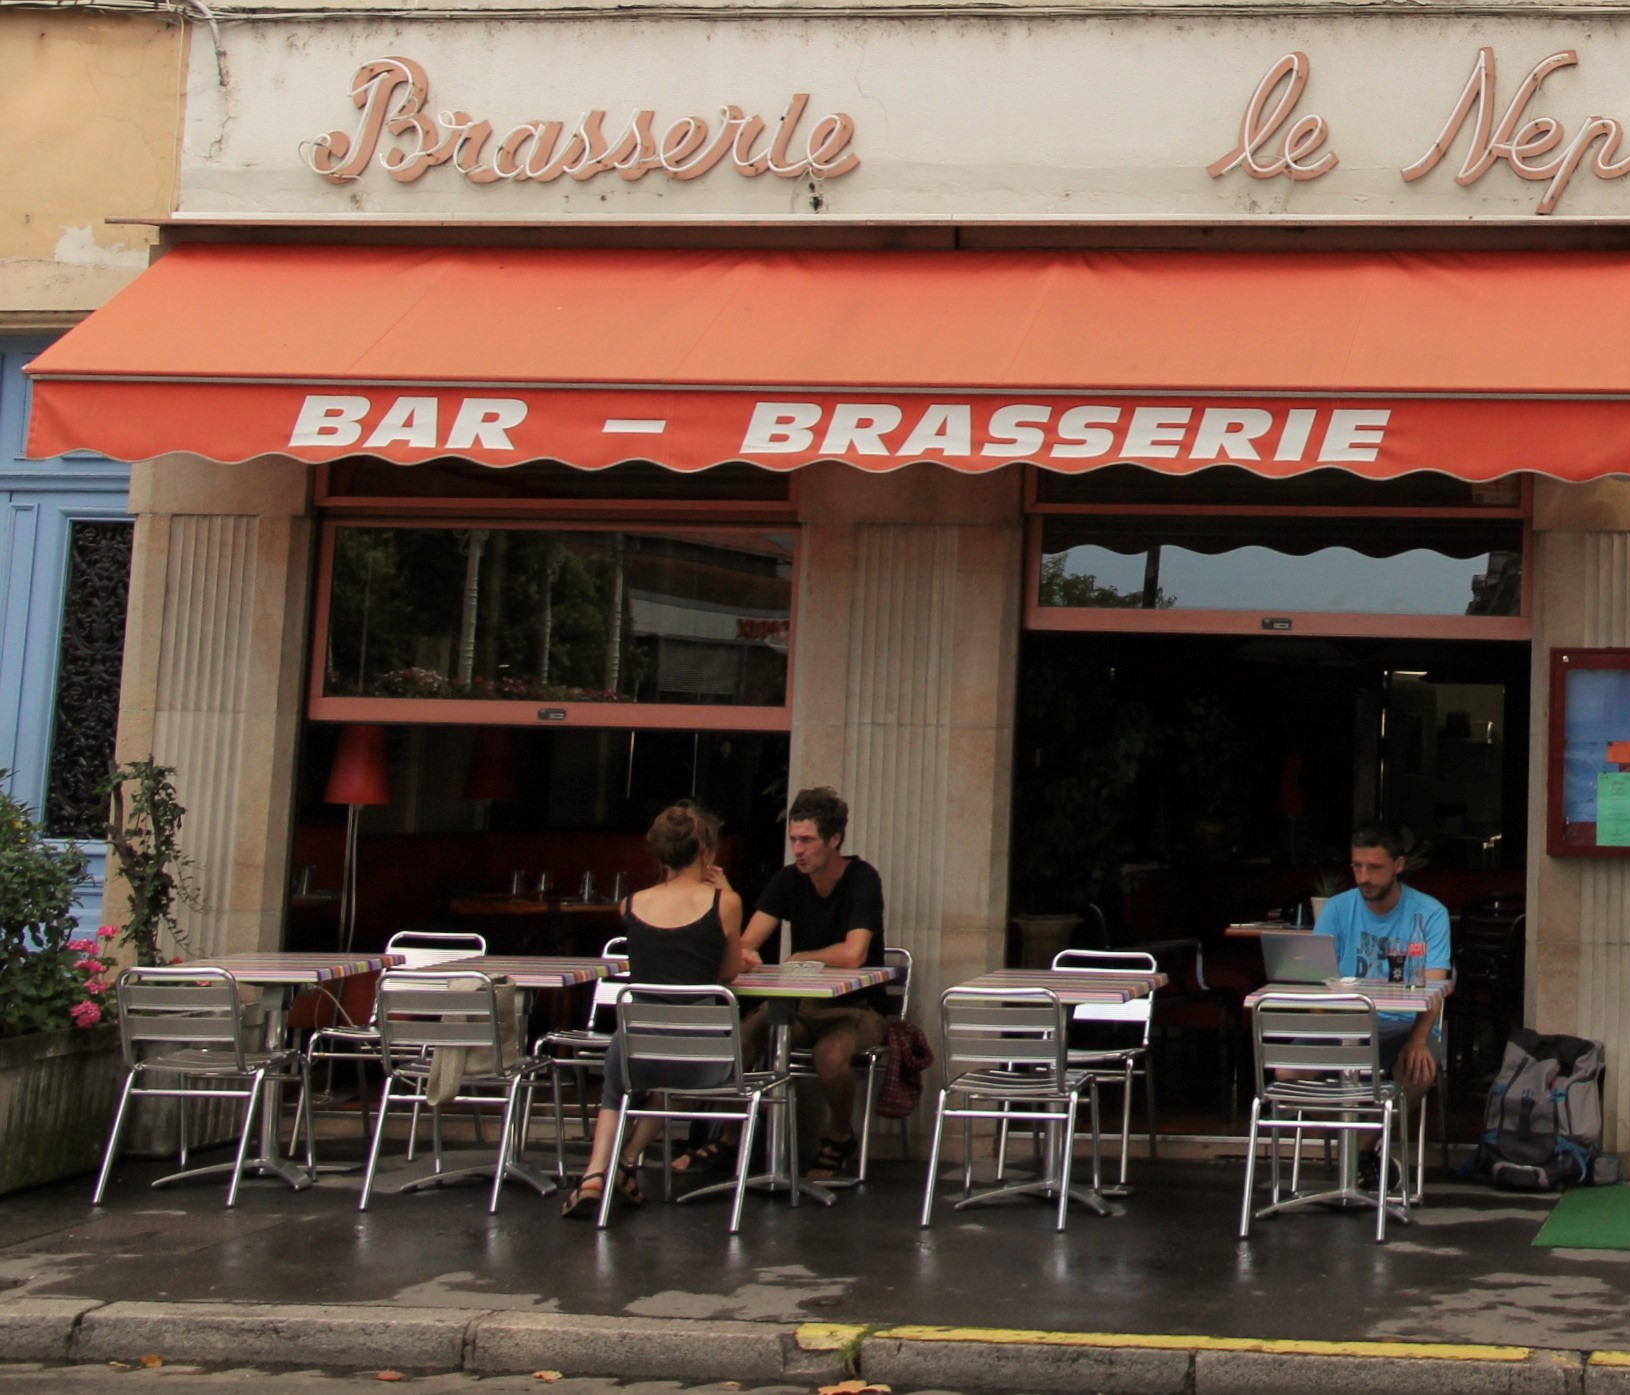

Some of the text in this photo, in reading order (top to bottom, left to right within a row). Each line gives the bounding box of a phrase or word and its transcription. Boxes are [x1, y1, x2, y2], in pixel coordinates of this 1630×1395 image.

[299, 56, 861, 187] Brasserie
[1206, 51, 1340, 182] le
[288, 395, 528, 451] BAR
[739, 401, 1391, 463] BRASSERIE
